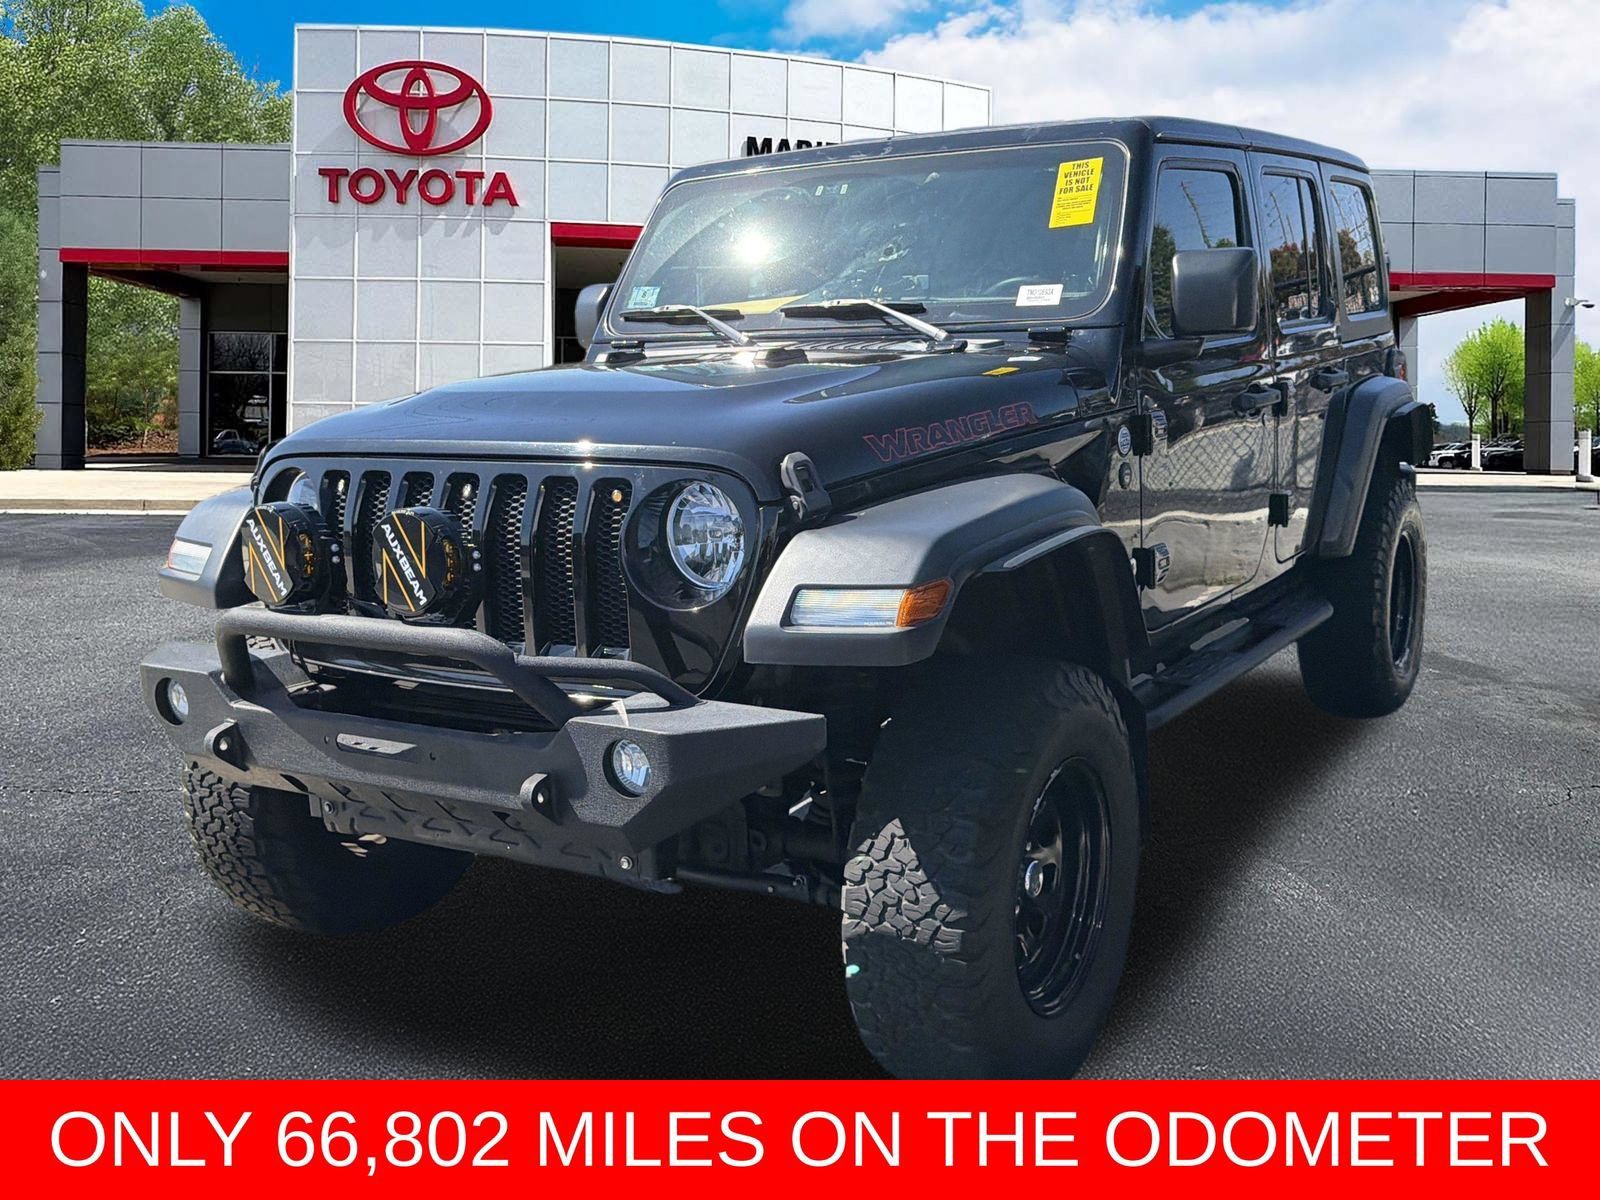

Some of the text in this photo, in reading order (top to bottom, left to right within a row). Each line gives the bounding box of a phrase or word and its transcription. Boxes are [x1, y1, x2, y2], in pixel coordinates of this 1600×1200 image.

[1064, 168, 1096, 179] VEHICLE
[1072, 161, 1090, 170] THIS
[318, 167, 520, 208] TOYOTA
[1059, 183, 1094, 195] FOR SALE
[1065, 176, 1090, 187] IS NOT
[862, 401, 1039, 462] WRANGLER
[246, 518, 288, 597] AUXBEAM
[381, 523, 428, 606] AUXBEAM
